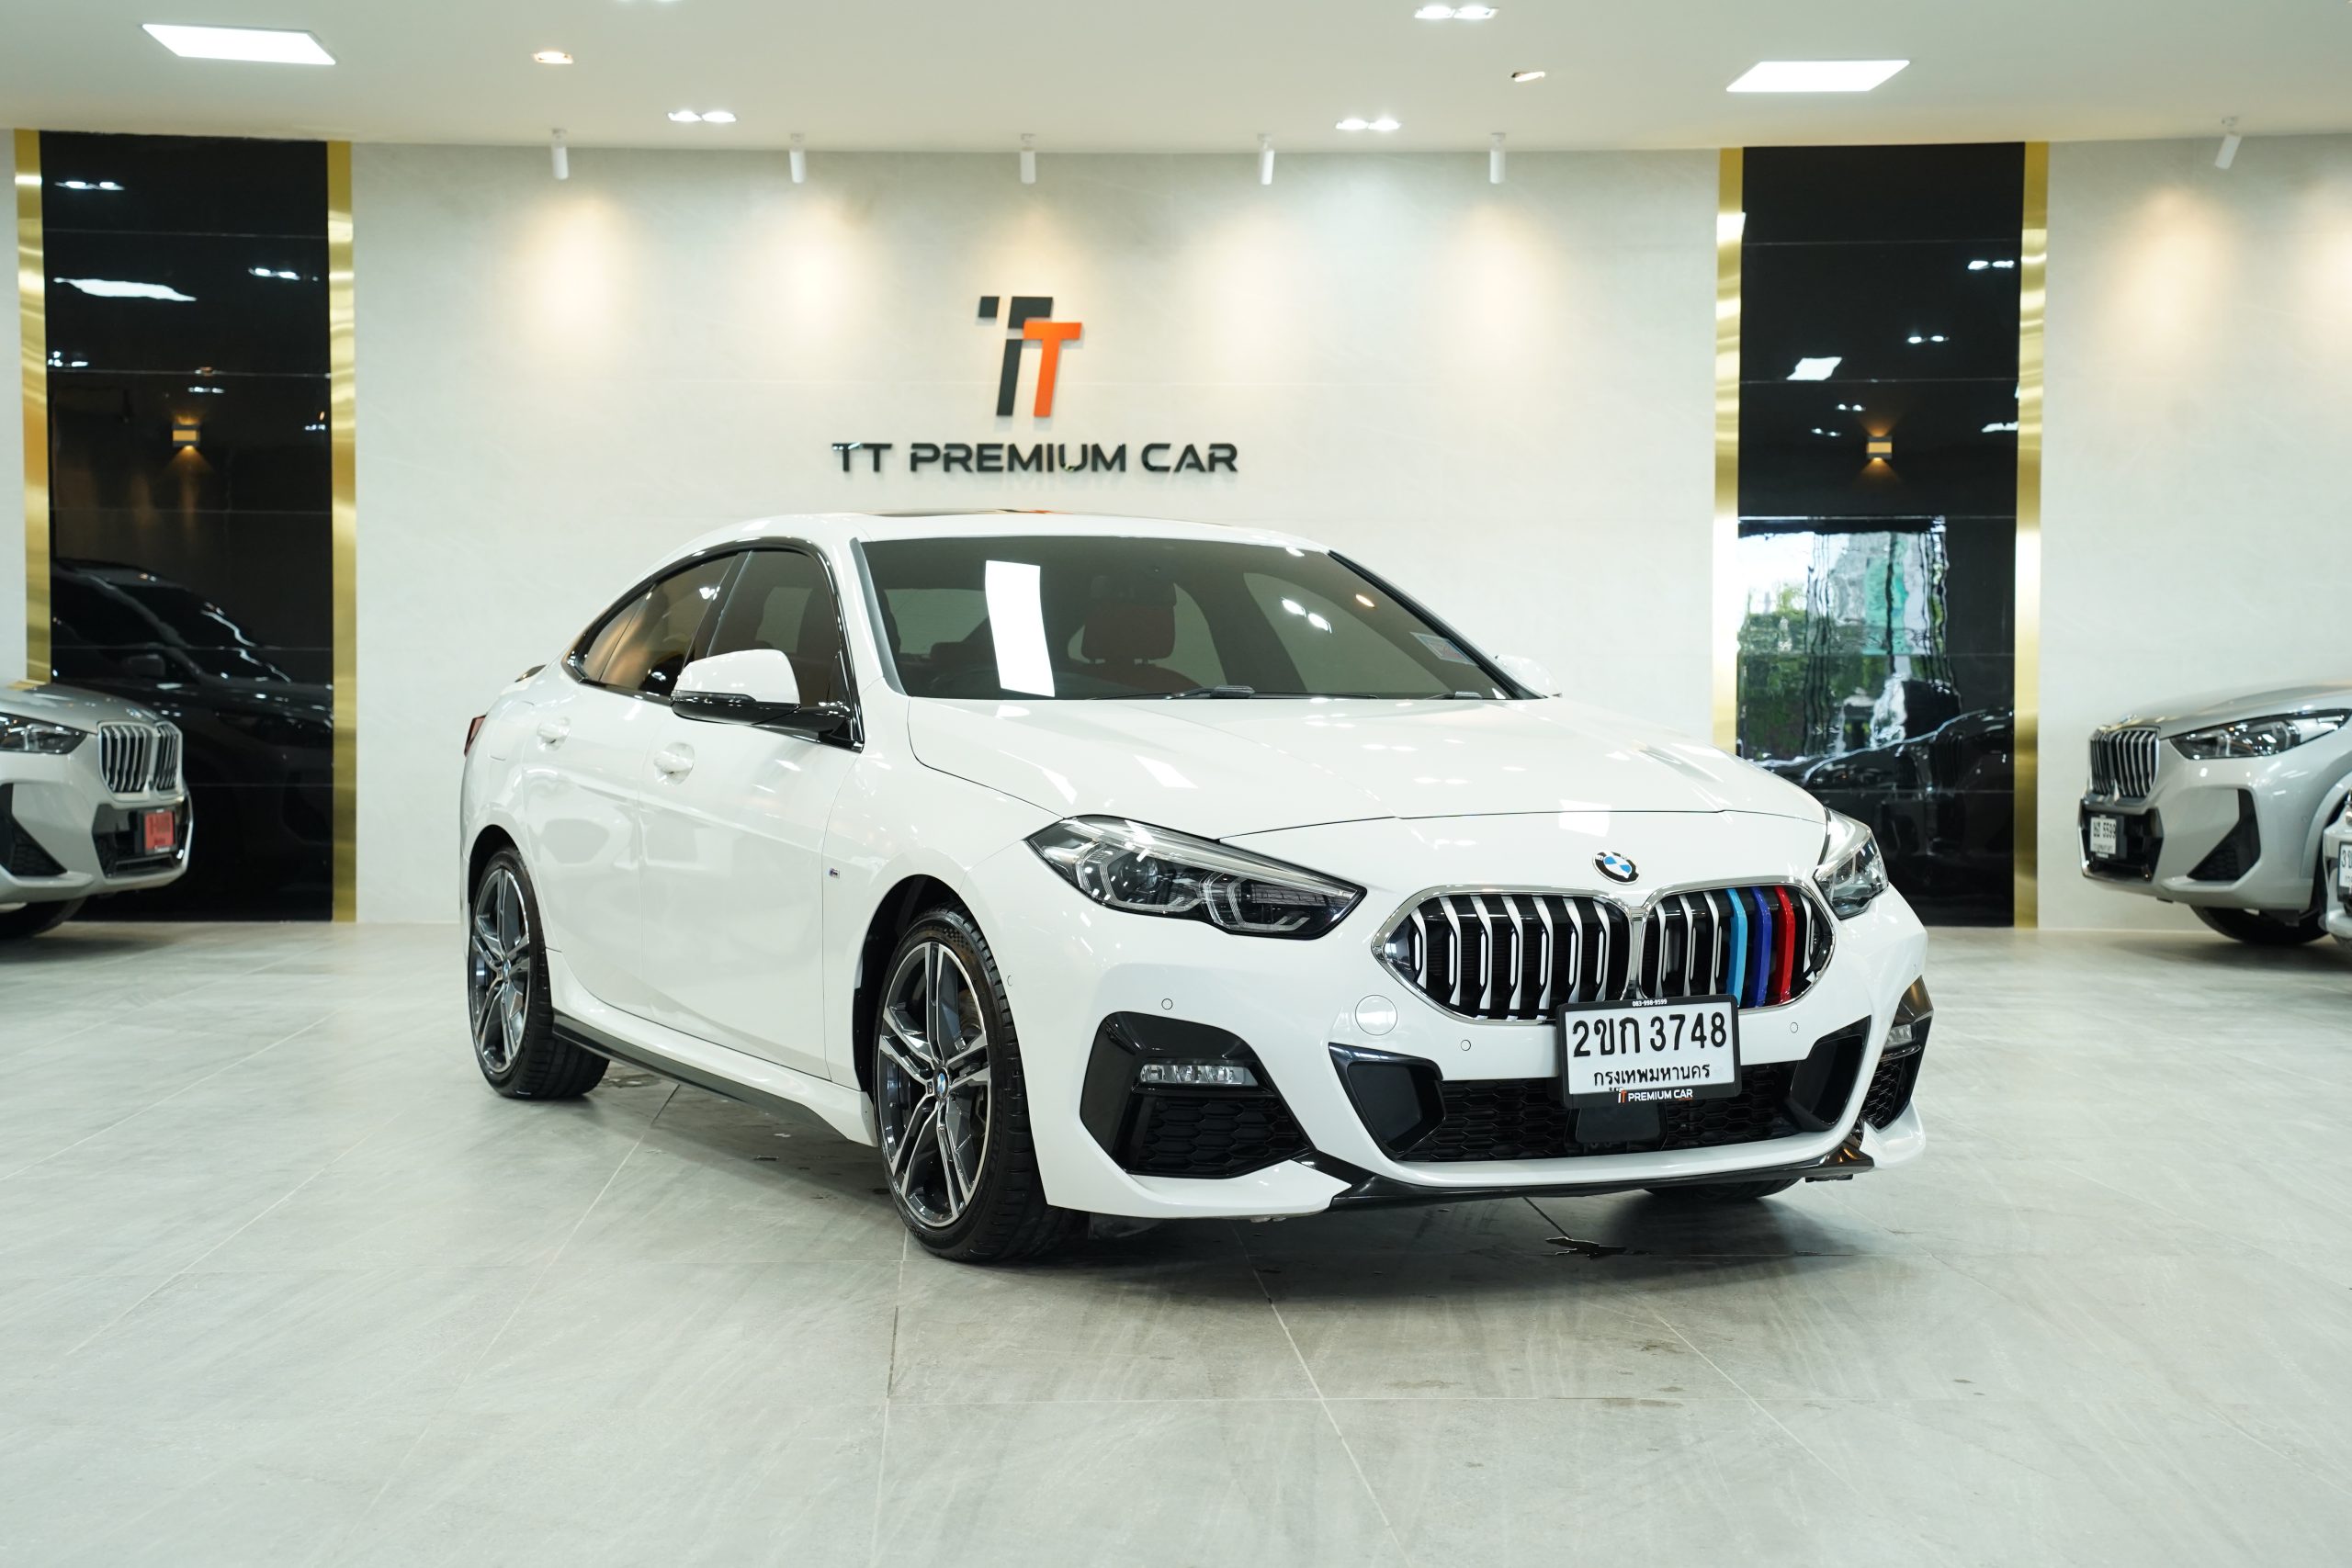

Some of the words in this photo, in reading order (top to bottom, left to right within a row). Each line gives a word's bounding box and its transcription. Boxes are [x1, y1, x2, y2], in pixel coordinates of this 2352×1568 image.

[831, 443, 893, 473] TT
[910, 443, 1126, 473] PREMIUM
[1141, 443, 1238, 473] CAR
[1572, 1016, 1641, 1057] 2ขก
[1649, 1011, 1727, 1052] 3748
[1593, 1064, 1710, 1086] กรุงเทพมหานคร
[1628, 1089, 1672, 1102] PREMIUM
[1673, 1089, 1693, 1099] CAR
